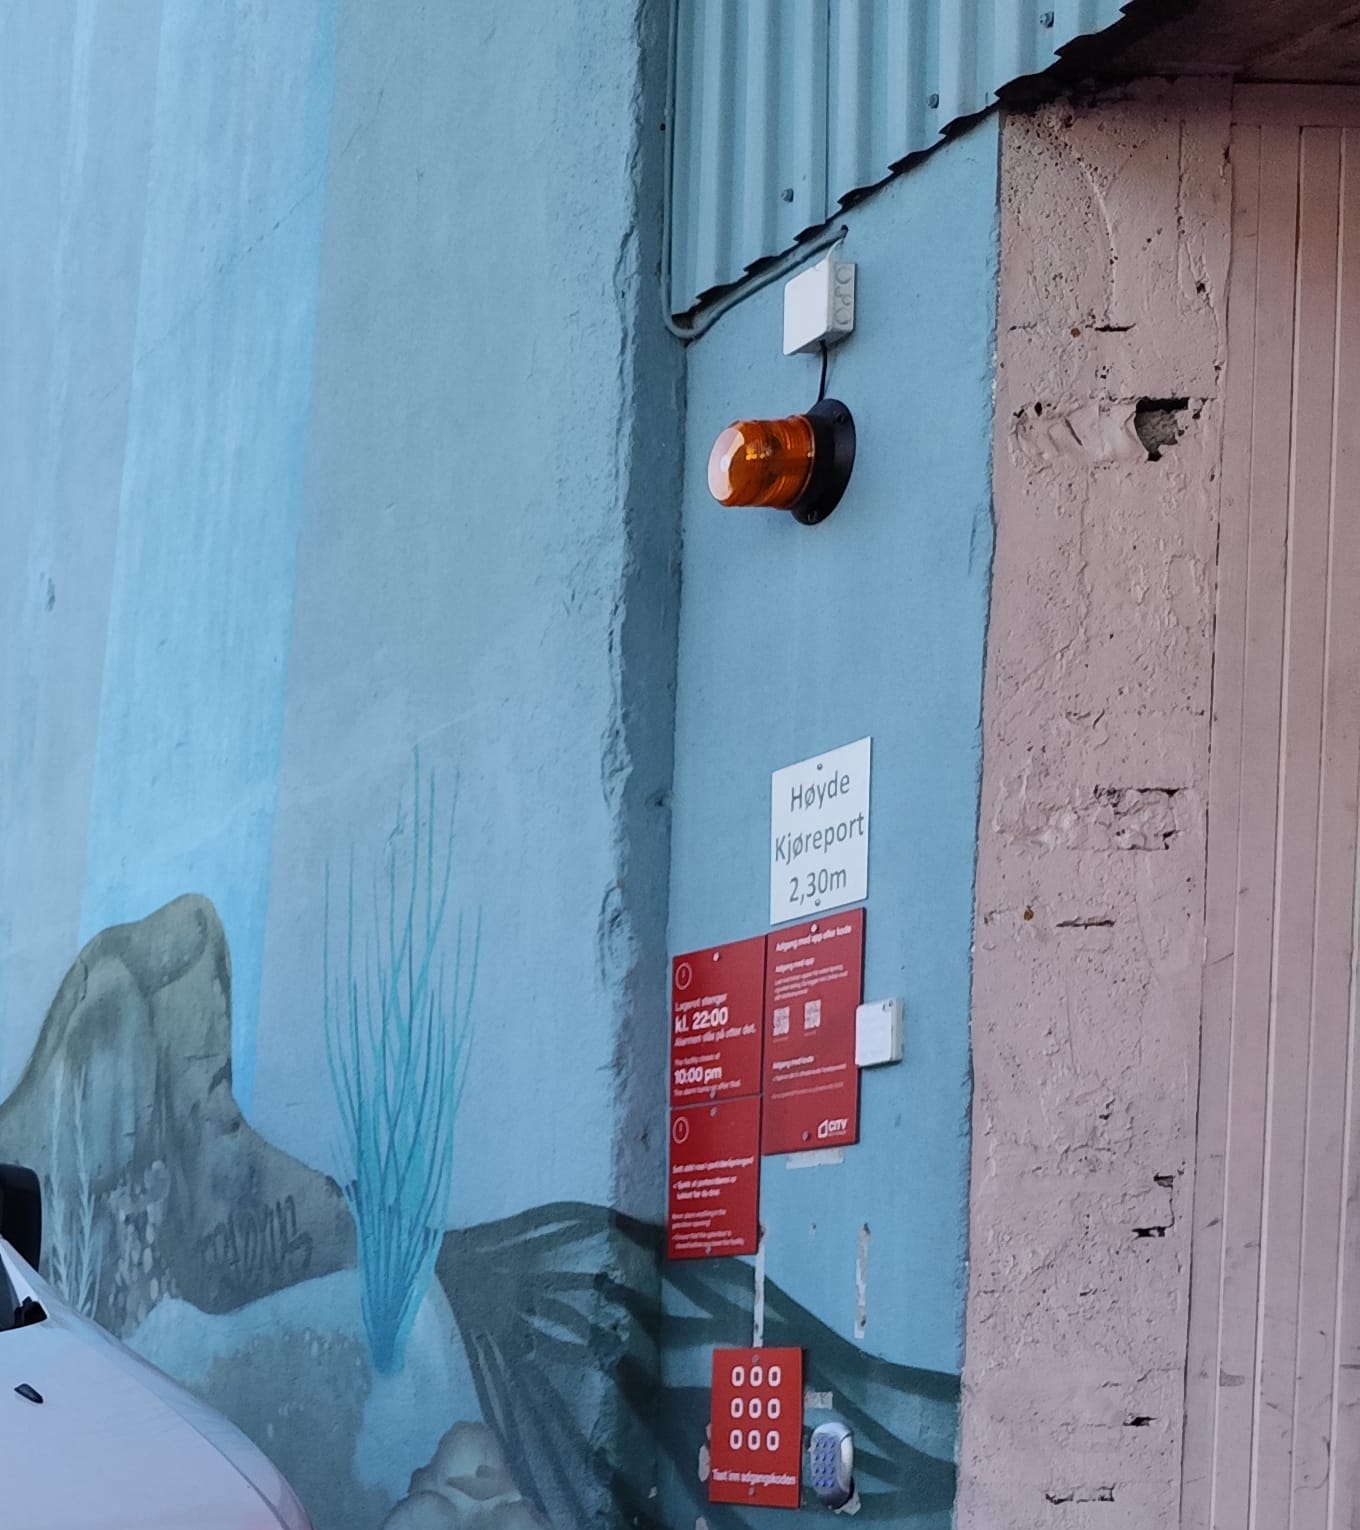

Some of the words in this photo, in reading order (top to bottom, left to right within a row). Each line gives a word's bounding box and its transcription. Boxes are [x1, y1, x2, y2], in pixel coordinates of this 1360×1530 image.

[790, 770, 850, 812] Høyde
[775, 812, 864, 865] Kjøreport
[788, 868, 847, 905] 2,30m
[692, 1007, 728, 1030] 22:00
[674, 1066, 703, 1084] 10:00
[704, 1068, 722, 1084] pm
